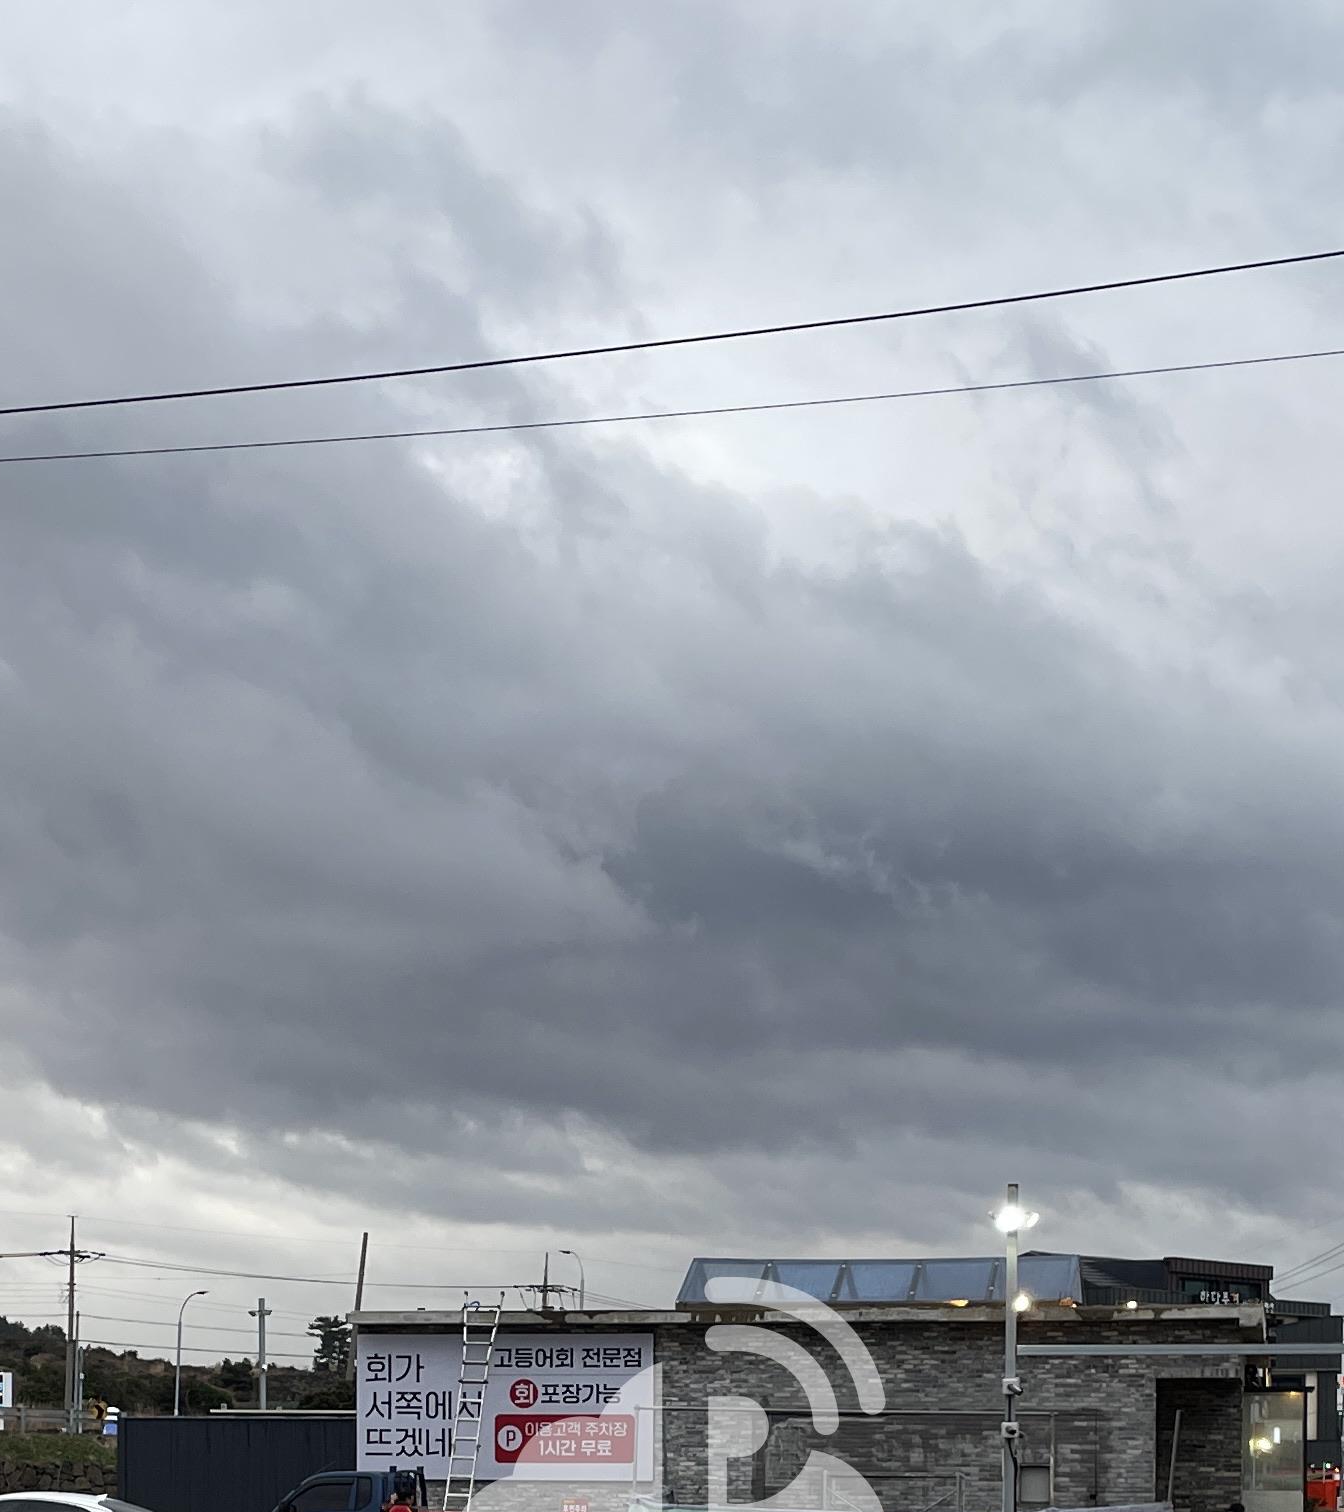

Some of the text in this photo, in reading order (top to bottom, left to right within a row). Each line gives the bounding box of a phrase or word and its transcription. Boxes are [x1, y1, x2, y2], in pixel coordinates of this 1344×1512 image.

[364, 1352, 425, 1383] 회가
[494, 1346, 643, 1369] 고등어회 전문점
[364, 1389, 483, 1421] 서쪽에서
[513, 1383, 622, 1405] 회 포장가능
[524, 1420, 628, 1437] 이용고객 주차장
[364, 1427, 454, 1458] 뜨겠네
[538, 1439, 613, 1457] 1시간 무료
